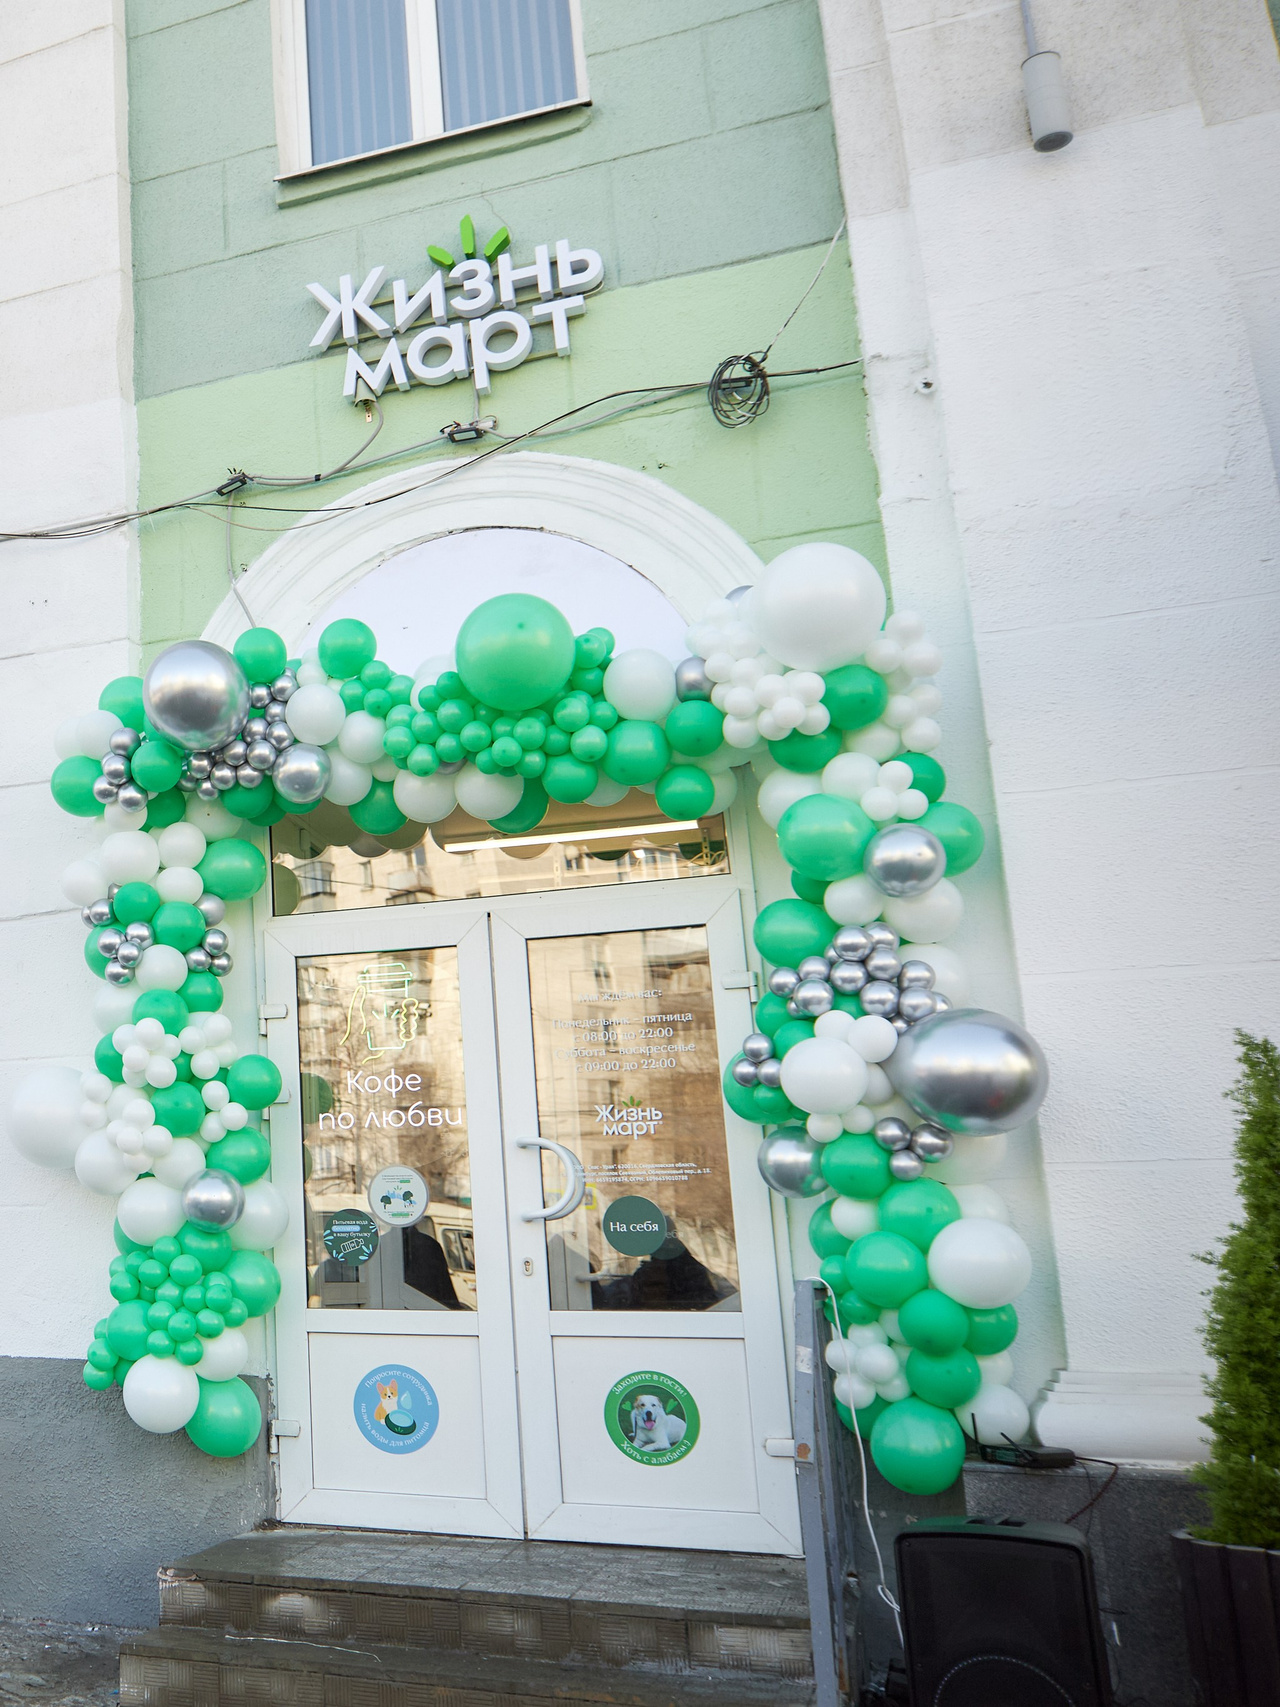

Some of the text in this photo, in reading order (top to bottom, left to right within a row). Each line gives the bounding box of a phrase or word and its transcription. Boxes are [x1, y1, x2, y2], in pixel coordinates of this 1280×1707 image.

[306, 239, 605, 352] Жизнь
[342, 295, 587, 396] март
[643, 1012, 693, 1025] пятница
[582, 1030, 617, 1042] 08:00
[639, 1027, 673, 1039] 22:00
[554, 1046, 606, 1059] Суббота
[619, 1043, 695, 1056] воскресенье
[584, 1060, 619, 1072] 09:00
[622, 1061, 638, 1071] до
[640, 1057, 676, 1069] 22:00
[346, 1068, 422, 1098] Кофе
[319, 1101, 463, 1130] по любви
[594, 1104, 663, 1122] Жизнь
[602, 1121, 659, 1140] март
[609, 1220, 659, 1232] На себя
[365, 1370, 432, 1406] Попросите сотрудника
[612, 1373, 652, 1395] Заходите
[659, 1376, 688, 1397] гости!
[371, 1430, 389, 1445] воды
[404, 1421, 430, 1446] питомца
[620, 1440, 642, 1460] Хоть
[651, 1445, 688, 1464] алабаем
